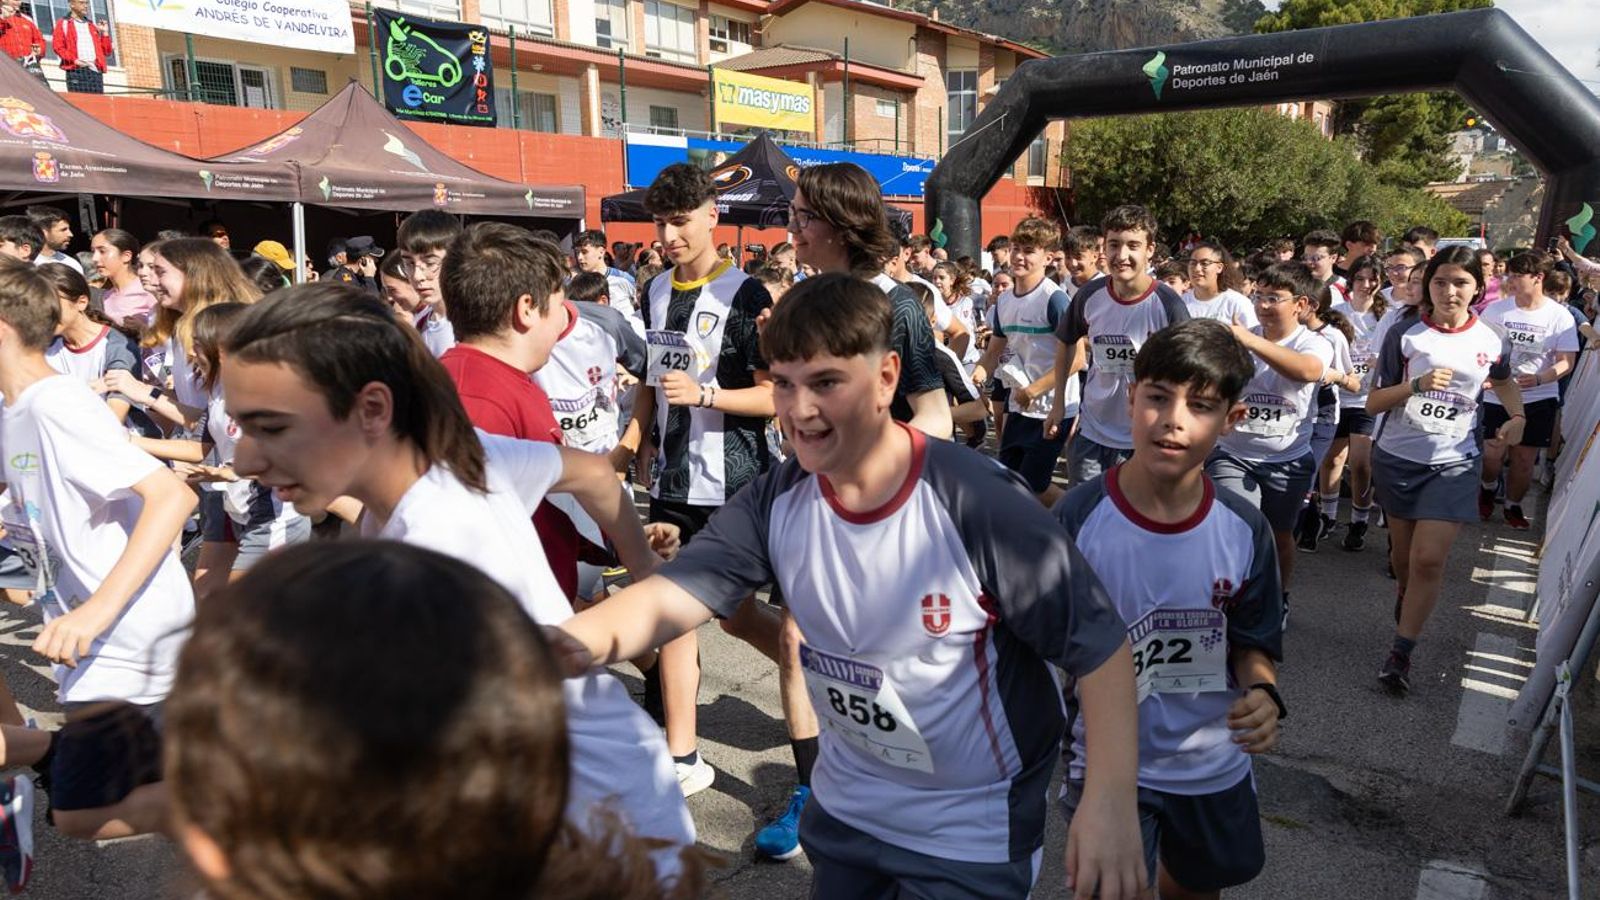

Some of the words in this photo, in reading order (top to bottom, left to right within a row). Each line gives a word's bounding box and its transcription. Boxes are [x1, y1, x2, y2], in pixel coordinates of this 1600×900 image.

[263, 1, 329, 20] Cooperativa
[195, 7, 249, 25] ANDRÉS
[253, 16, 270, 29] DE
[275, 18, 348, 38] VANDELVIRA
[1172, 61, 1230, 76] Patronato
[1233, 54, 1294, 71] Municipal
[1297, 52, 1314, 64] de
[1172, 75, 1226, 90] Deportes
[1229, 72, 1245, 84] de
[1249, 69, 1279, 83] Jaén
[738, 86, 811, 114] masymas
[1509, 331, 1535, 344] 364
[660, 351, 690, 371] 429
[1106, 347, 1137, 361] 949
[560, 406, 599, 431] 864
[1249, 406, 1282, 422] 931
[1420, 402, 1459, 421] 862
[1176, 618, 1209, 627] GLORIA
[827, 687, 897, 732] 858
